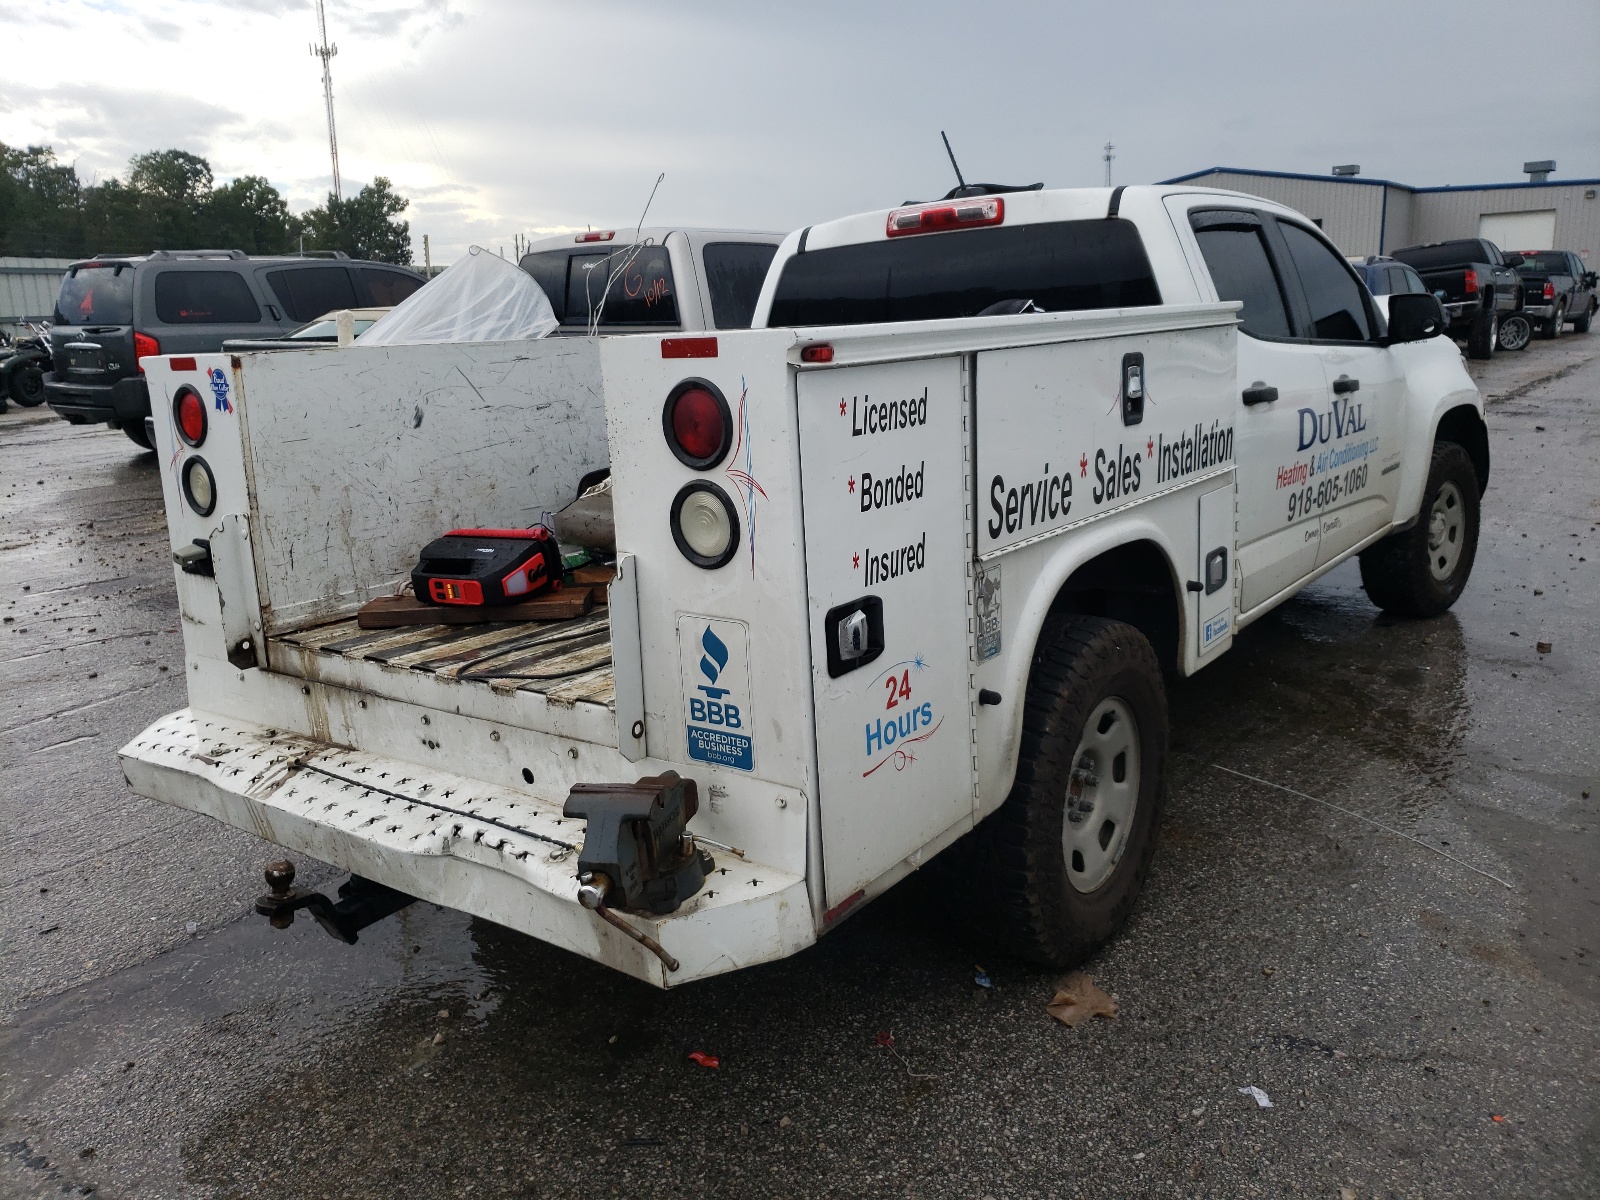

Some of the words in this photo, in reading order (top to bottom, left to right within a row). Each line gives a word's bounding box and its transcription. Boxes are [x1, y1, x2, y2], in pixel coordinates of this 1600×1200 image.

[852, 387, 928, 437] Licensed
[860, 460, 925, 513] Bonded
[988, 462, 1073, 540] Service
[1092, 443, 1141, 505] Sales
[1157, 418, 1233, 484] Installation
[1276, 461, 1308, 490] Heating
[1309, 455, 1315, 477] &
[1316, 452, 1329, 475] Air
[1329, 438, 1369, 470] Conditioning
[1287, 463, 1368, 522] 918-605-1060
[864, 531, 926, 588] Insured
[689, 697, 742, 729] BBB
[885, 668, 912, 710] 24
[690, 729, 749, 749] ACCREDITED
[698, 739, 743, 757] BUSINESS
[865, 701, 933, 757] Hours
[707, 751, 735, 764] bbb.org
